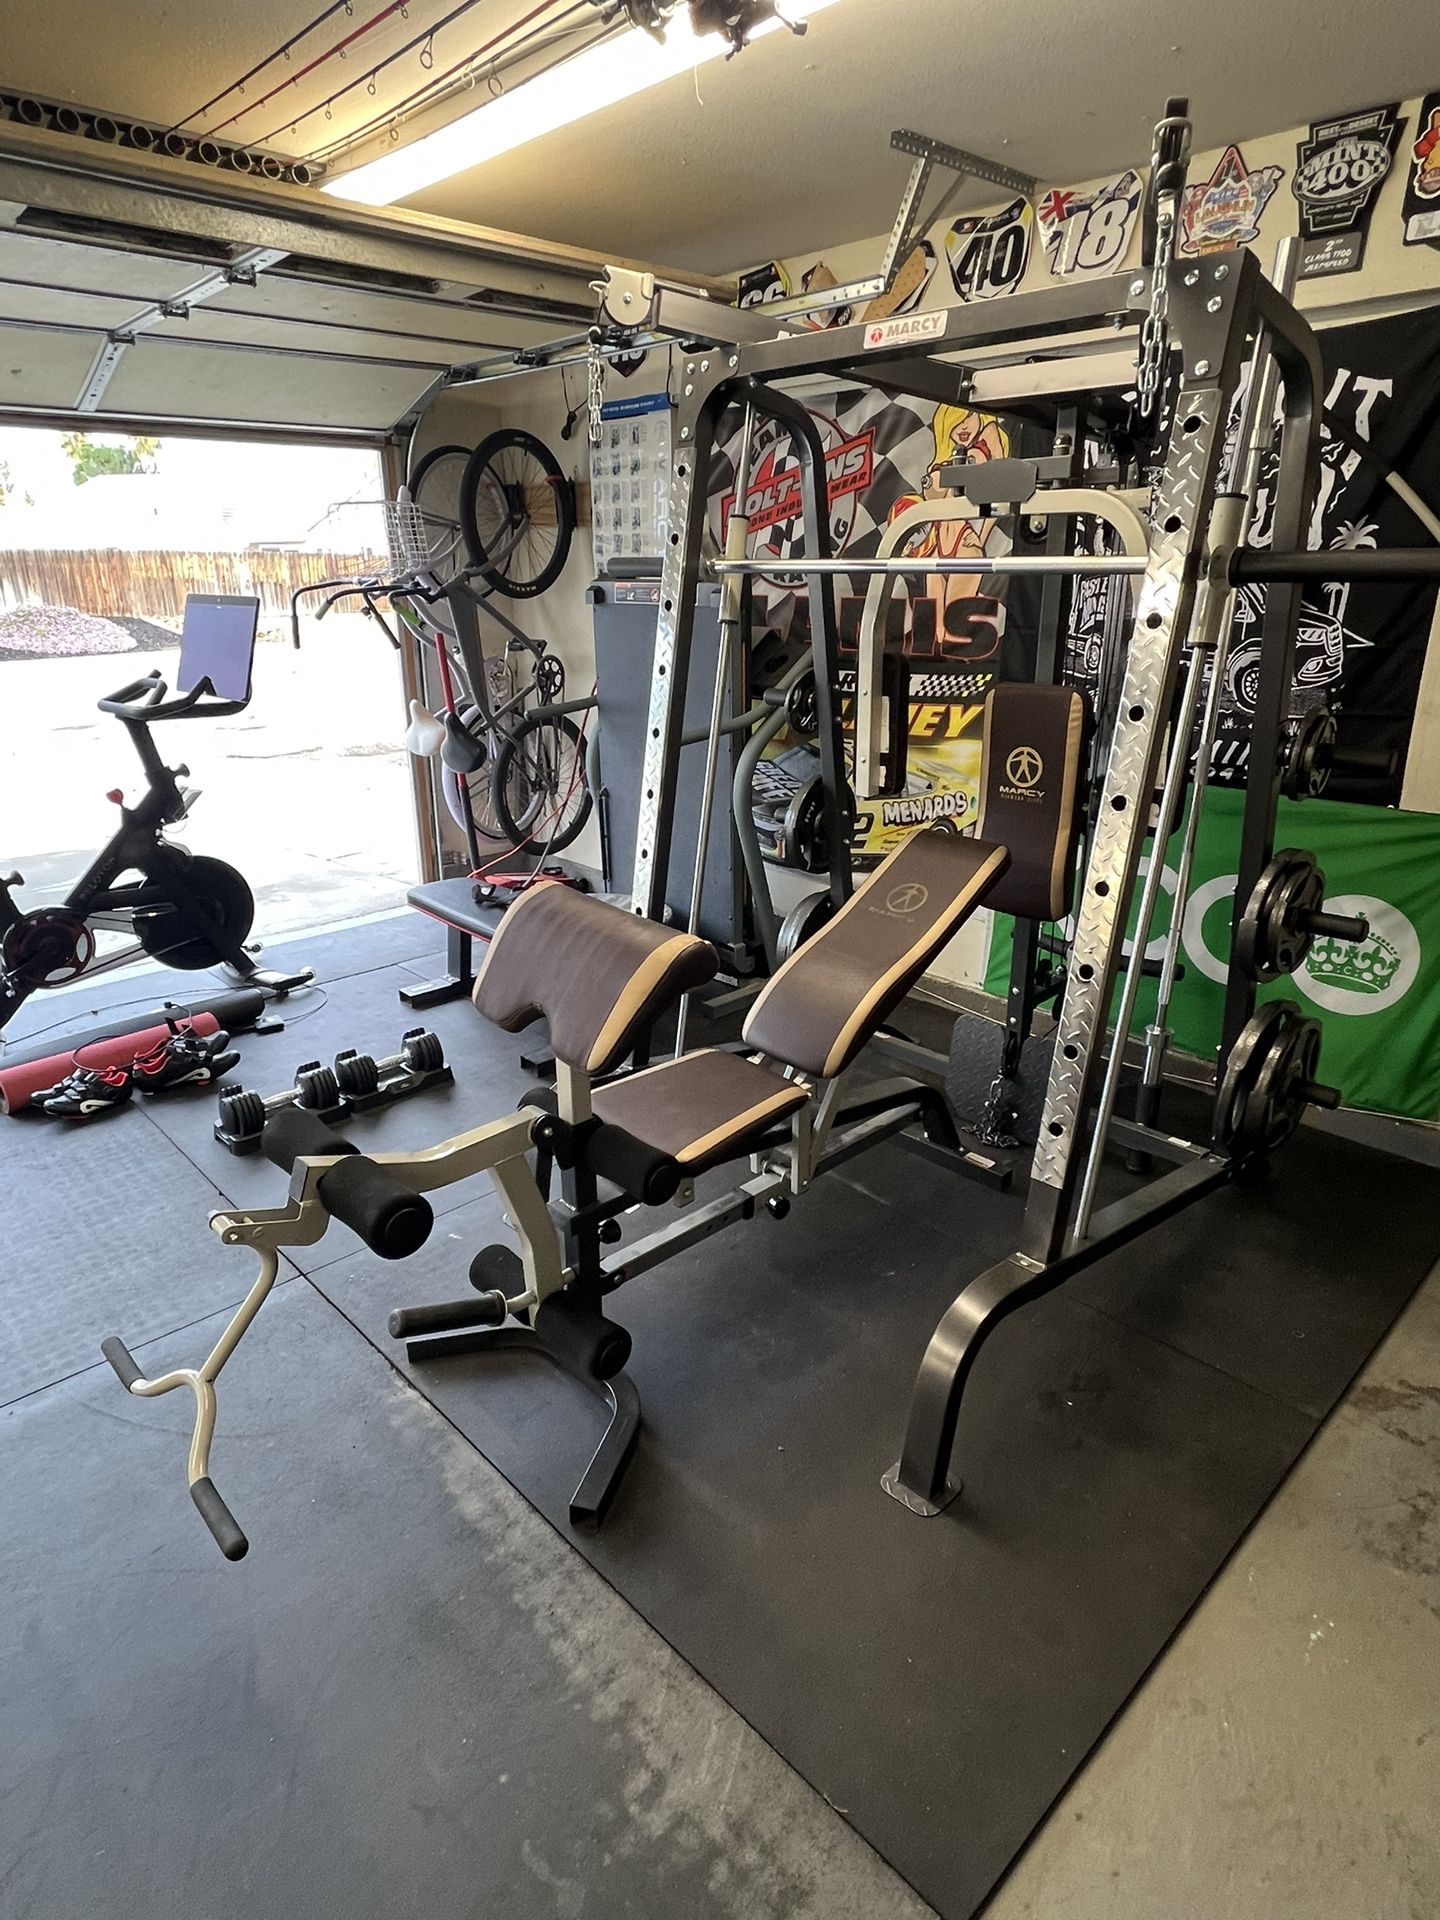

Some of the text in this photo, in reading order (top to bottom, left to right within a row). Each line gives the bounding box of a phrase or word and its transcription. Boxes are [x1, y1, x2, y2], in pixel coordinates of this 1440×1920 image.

[1303, 143, 1380, 178] MINT
[1308, 159, 1371, 193] 400
[1050, 199, 1130, 276] 18
[956, 225, 1026, 291] 40
[1304, 251, 1331, 264] CLASS
[886, 316, 941, 337] MARCY
[830, 471, 868, 493] WEAR
[882, 791, 968, 827] MENARDS
[999, 785, 1046, 799] MARCY
